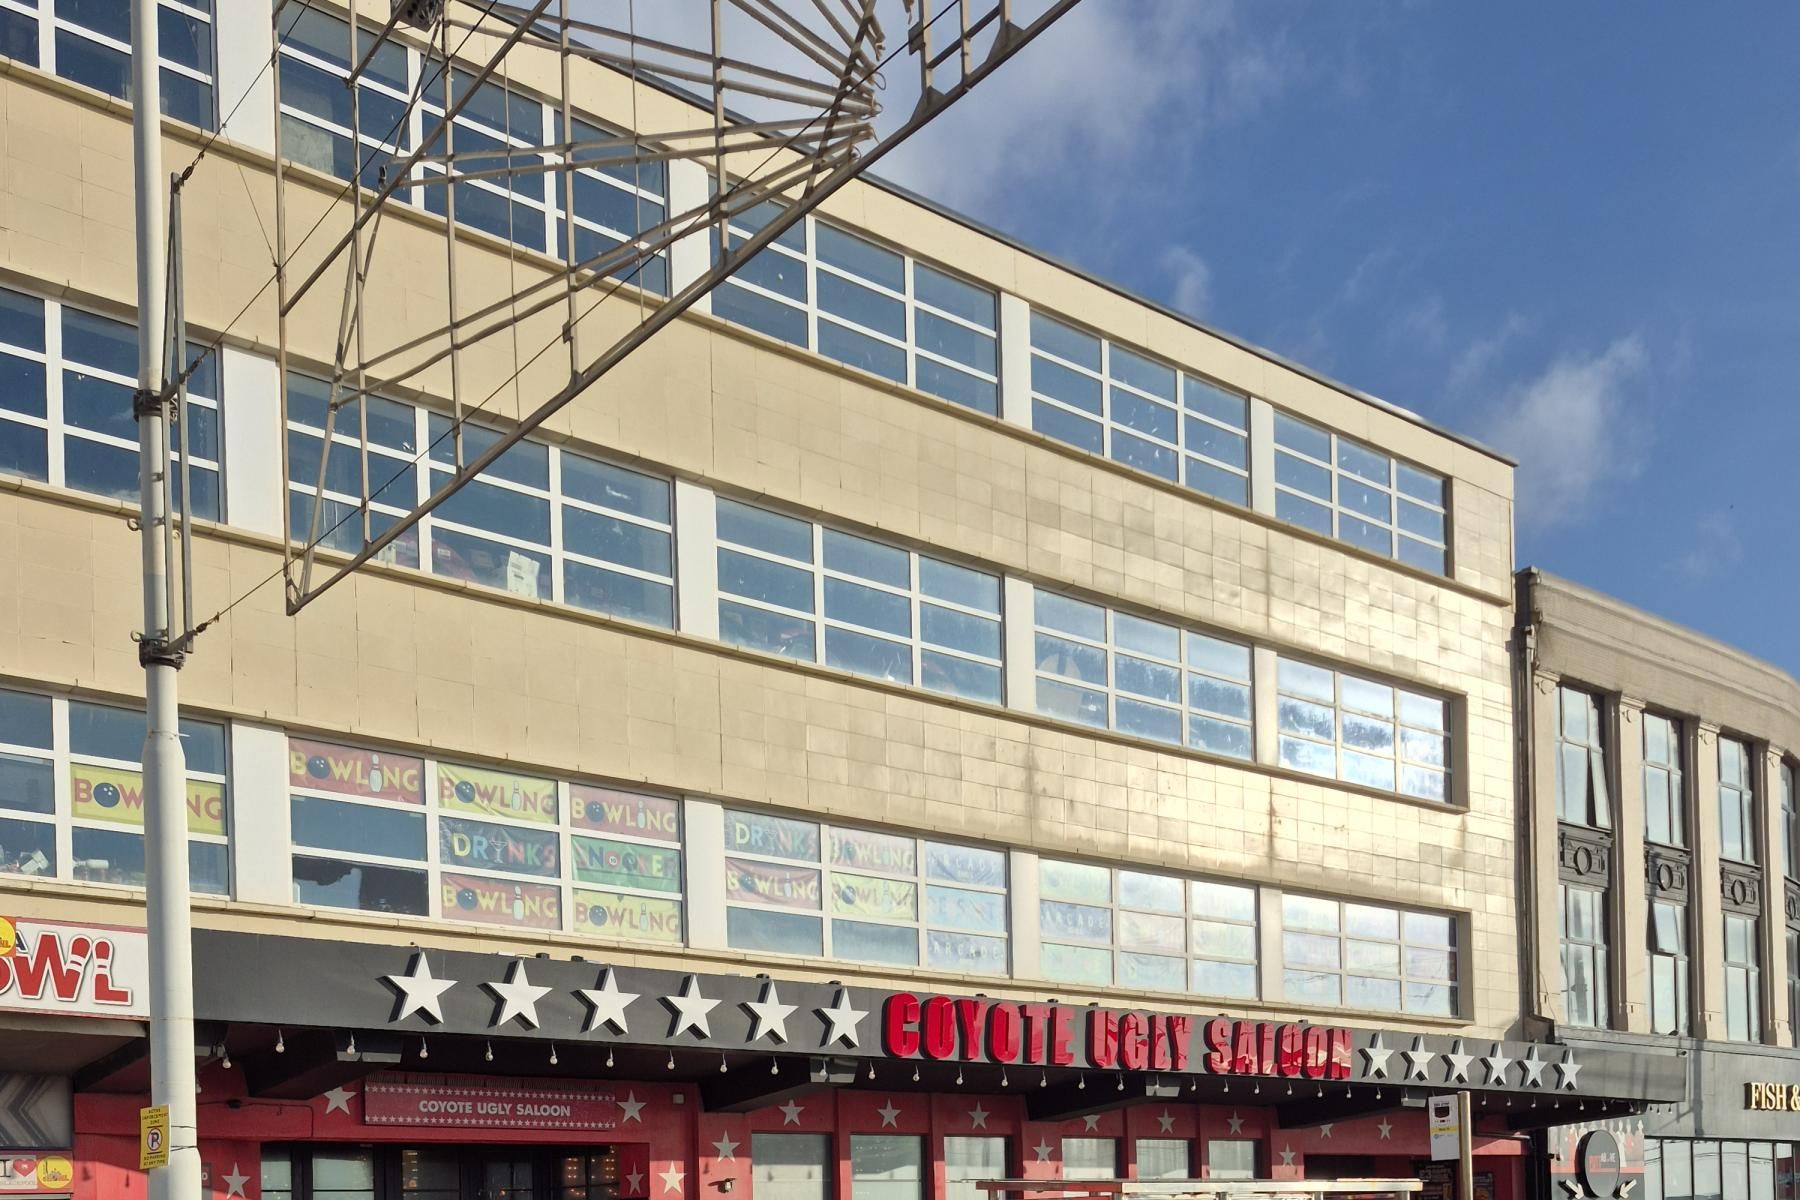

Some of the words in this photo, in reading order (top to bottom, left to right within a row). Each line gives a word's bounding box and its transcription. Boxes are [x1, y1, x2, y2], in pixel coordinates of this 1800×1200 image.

[290, 751, 420, 793] BOWLING
[75, 778, 223, 820] BOWNG
[440, 776, 556, 815] BOWLING
[571, 797, 677, 833] BOWLING
[443, 883, 558, 921] BOWLING
[727, 870, 817, 900] BOWLING
[576, 902, 678, 933] BOWLING
[881, 992, 1074, 1065] COYOTE
[1085, 1008, 1194, 1071] UGLY
[1203, 1017, 1353, 1080] SALOON
[419, 1100, 473, 1114] COYOTE
[477, 1101, 512, 1115] UGLY
[516, 1103, 571, 1117] SALOON
[1747, 1082, 1788, 1110] FISH
